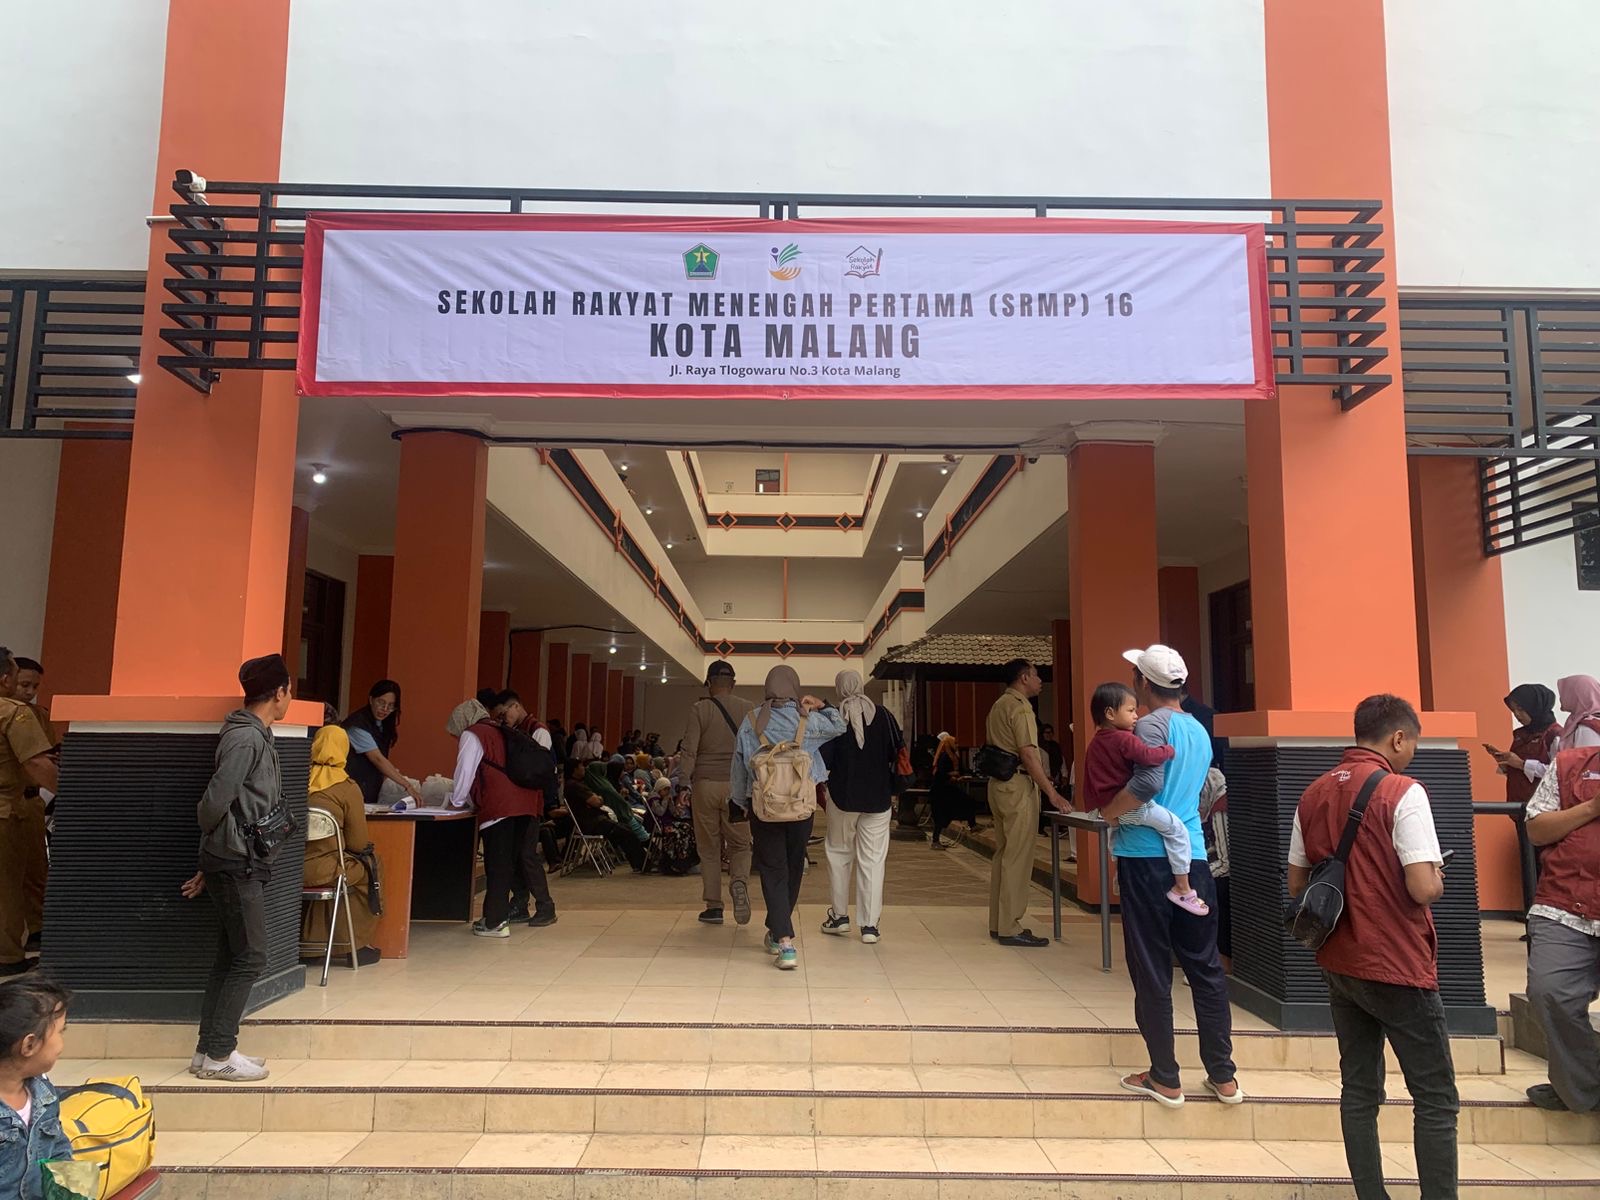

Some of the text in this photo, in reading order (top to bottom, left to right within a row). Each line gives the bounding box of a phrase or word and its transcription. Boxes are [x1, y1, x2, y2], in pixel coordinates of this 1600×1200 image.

[437, 290, 1134, 318] SEKOLAH RAKYAT MENENGAH PERTAMA (SRMP) 16
[650, 323, 921, 359] KOTA MALANG
[669, 364, 901, 379] Jl. Raya Tlogowaru No.3 Kota Malang
